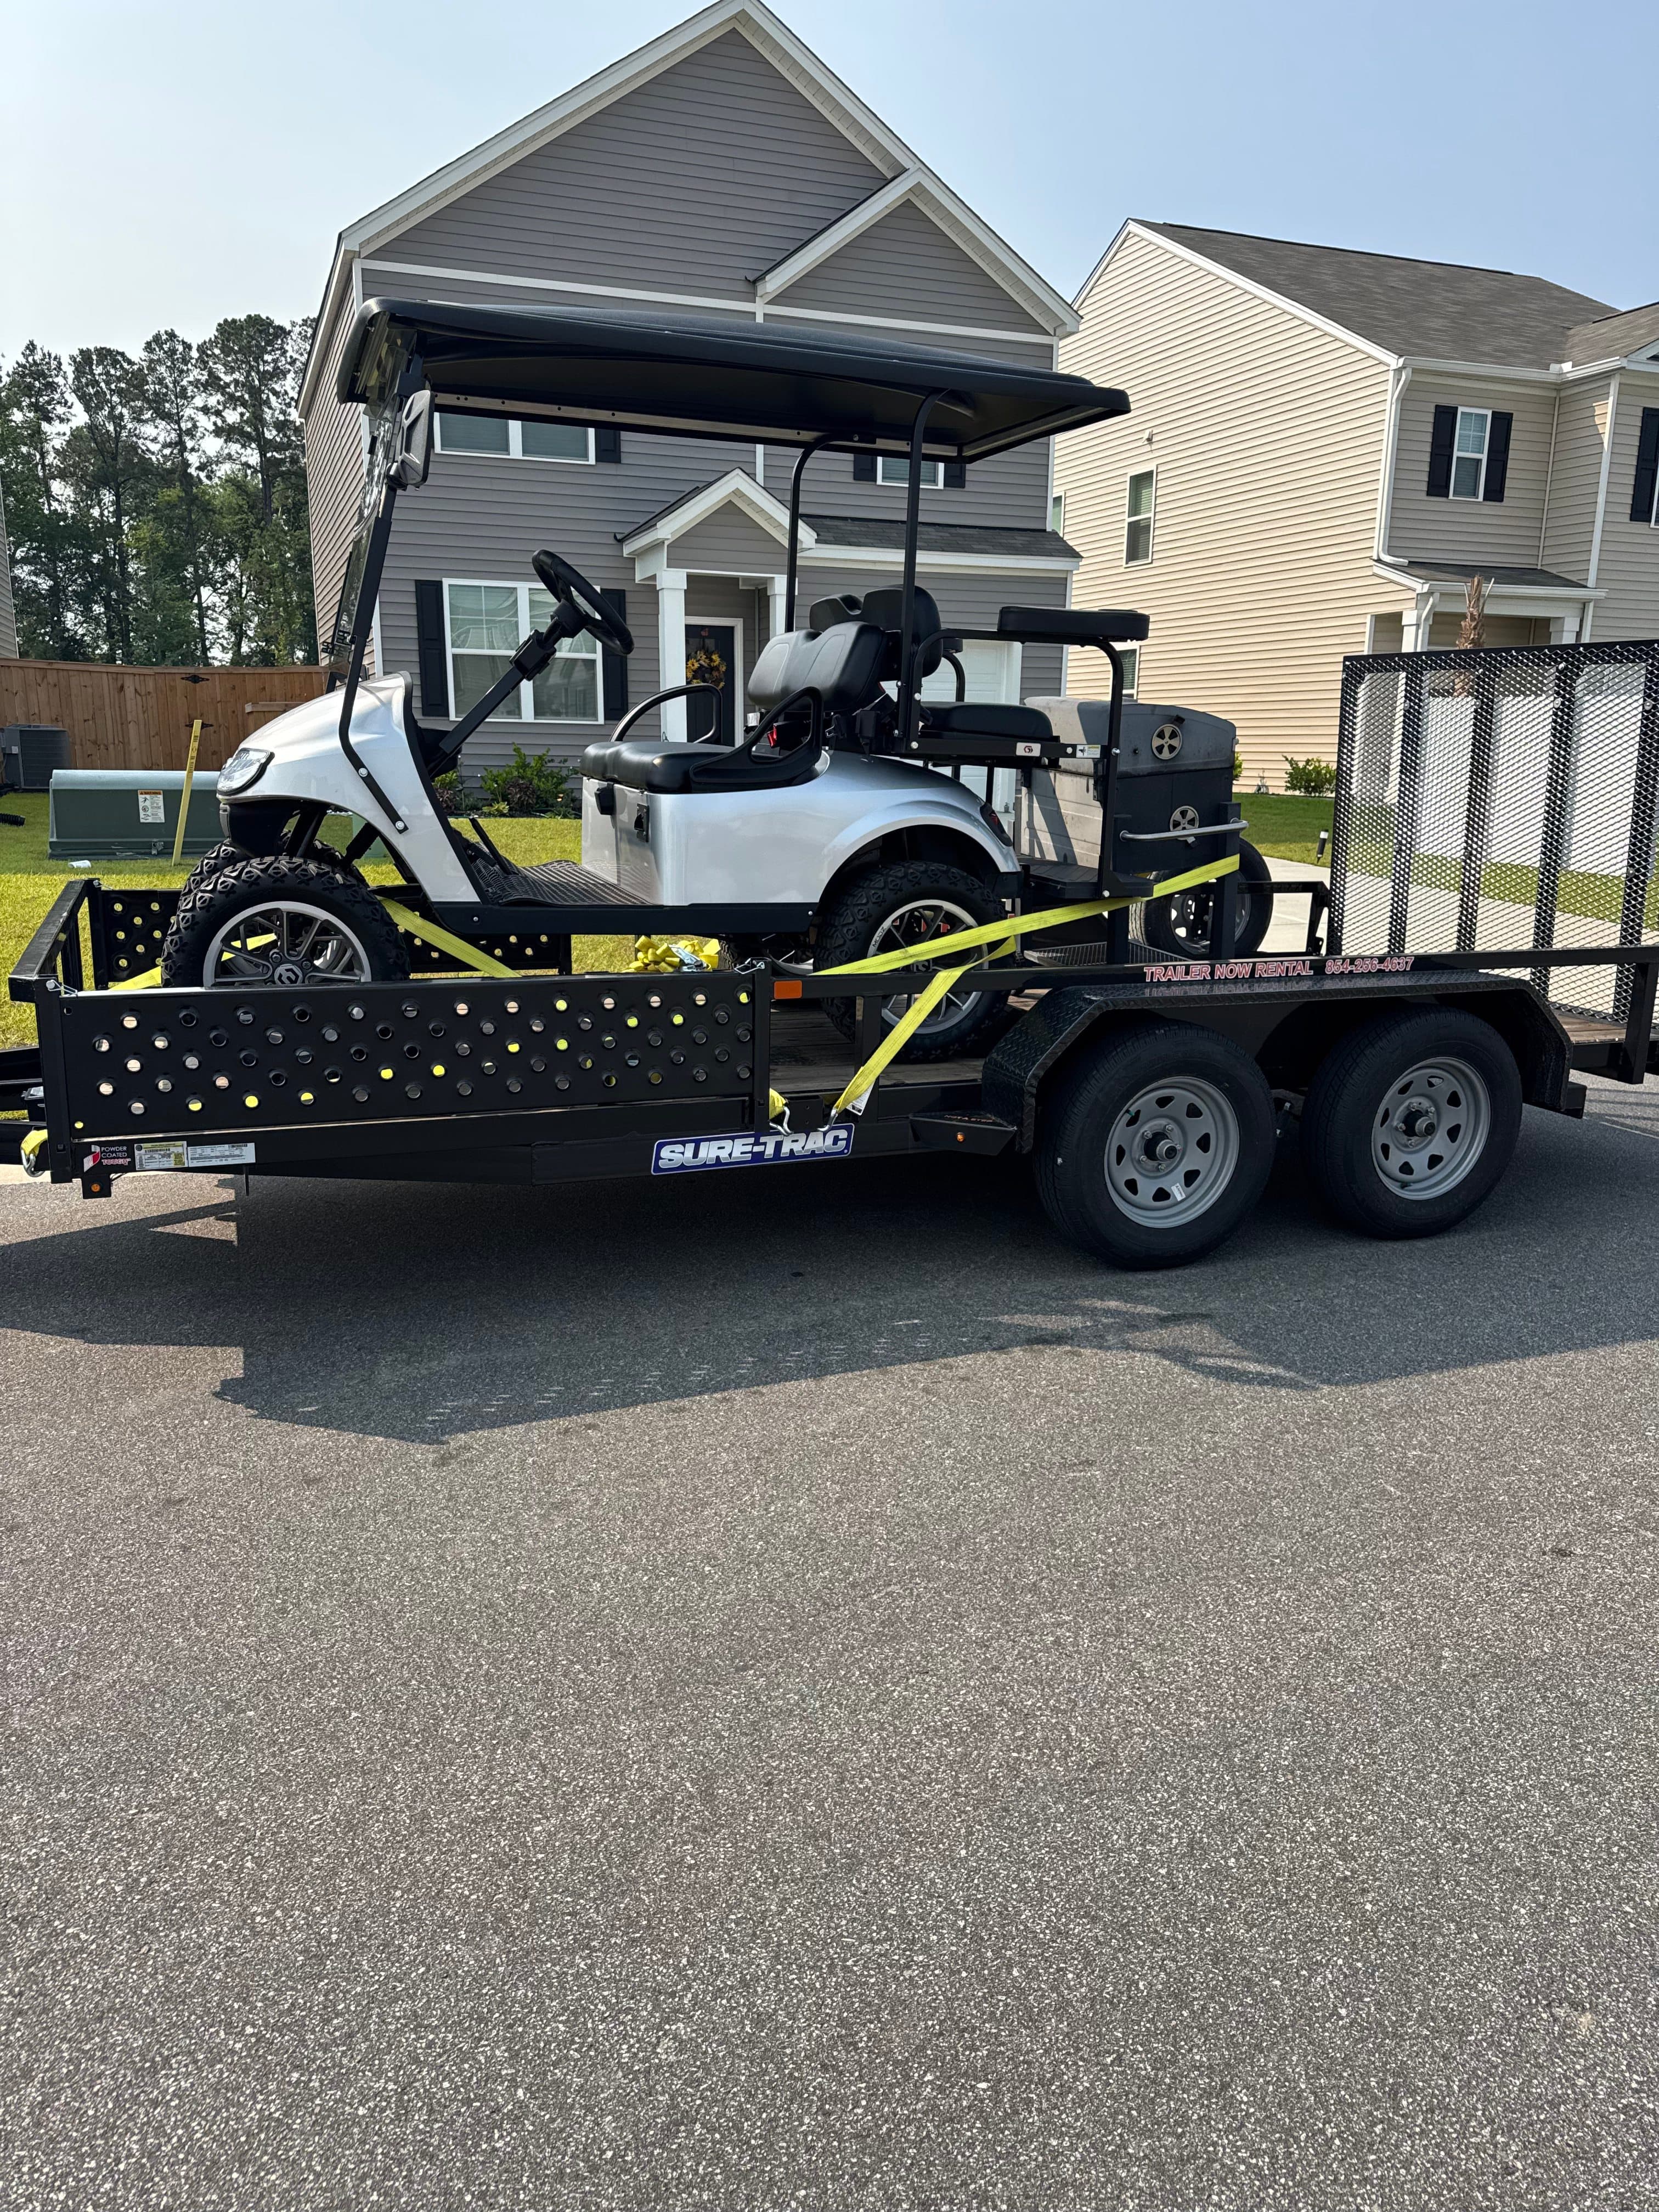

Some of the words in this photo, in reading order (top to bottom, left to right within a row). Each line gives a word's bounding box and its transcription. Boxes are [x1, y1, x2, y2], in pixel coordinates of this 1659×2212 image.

[1144, 964, 1211, 982] TRAILER
[1214, 963, 1252, 979] NOW
[1255, 960, 1313, 977] RENTAL
[1325, 957, 1414, 974] 854-256-4637
[658, 1129, 848, 1169] SURE-TRAC
